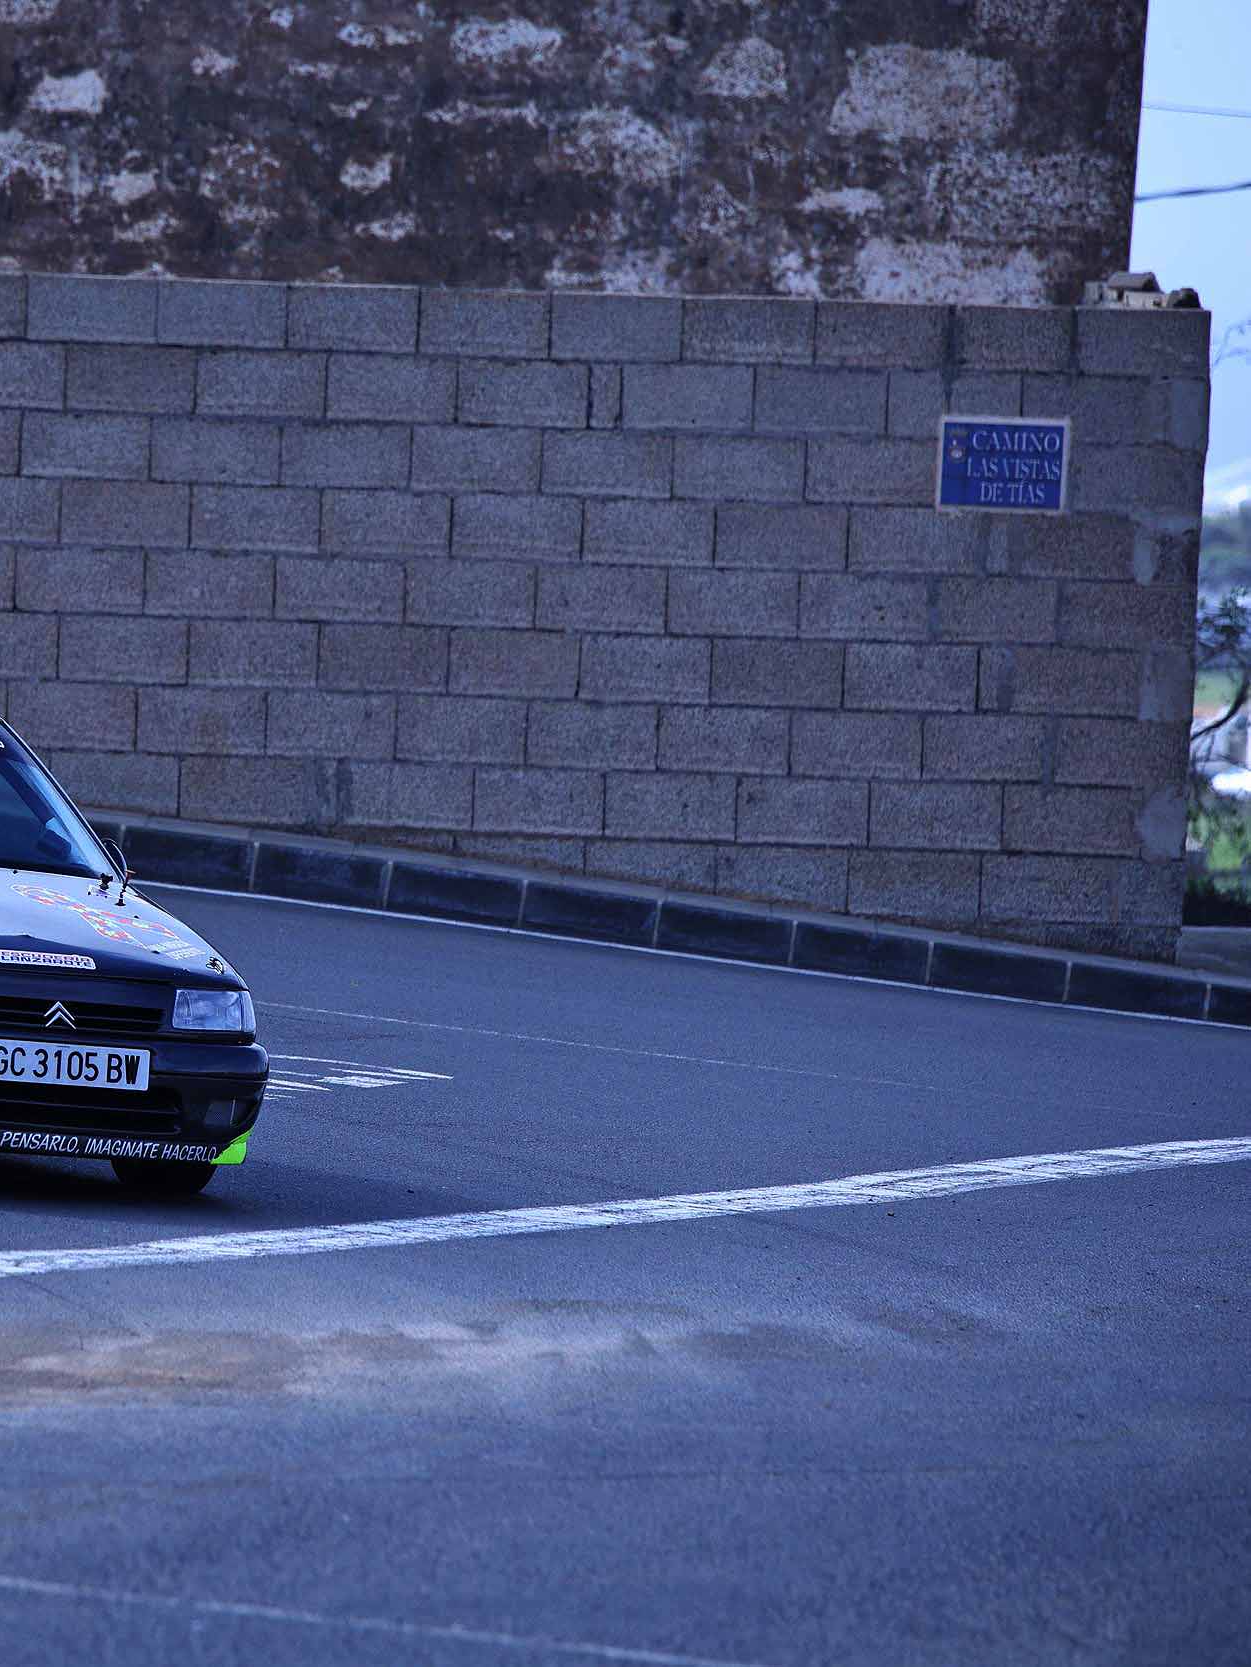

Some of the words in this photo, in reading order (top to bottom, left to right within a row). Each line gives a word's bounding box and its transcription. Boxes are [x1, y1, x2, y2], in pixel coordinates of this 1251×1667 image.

[972, 431, 1061, 452] CAMINO
[966, 457, 999, 478] LAS
[1003, 458, 1061, 480] VISTAS
[980, 482, 1003, 503] DE
[32, 1048, 100, 1082] 3105
[106, 1053, 141, 1085] BW
[0, 1131, 80, 1153] PENSARLO,
[84, 1137, 160, 1159] IMAGINATE
[161, 1143, 217, 1163] HACERLO
